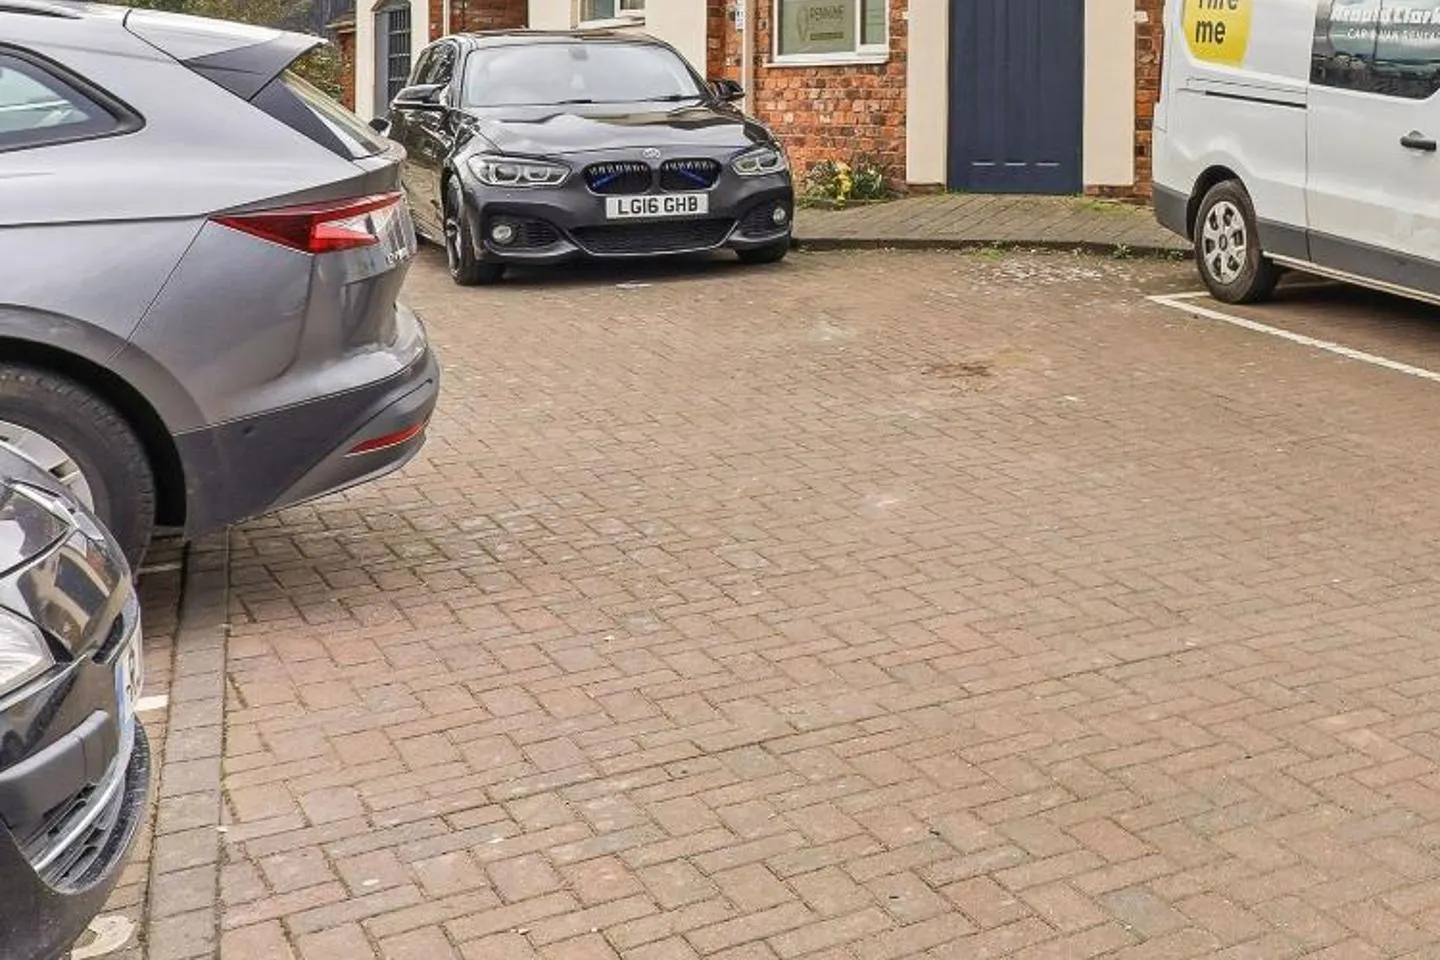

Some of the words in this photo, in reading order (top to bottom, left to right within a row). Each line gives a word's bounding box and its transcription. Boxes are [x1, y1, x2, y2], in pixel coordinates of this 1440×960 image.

[1195, 20, 1226, 44] me
[1347, 28, 1368, 40] CAR
[617, 198, 660, 215] LG16
[663, 196, 698, 213] GHB
